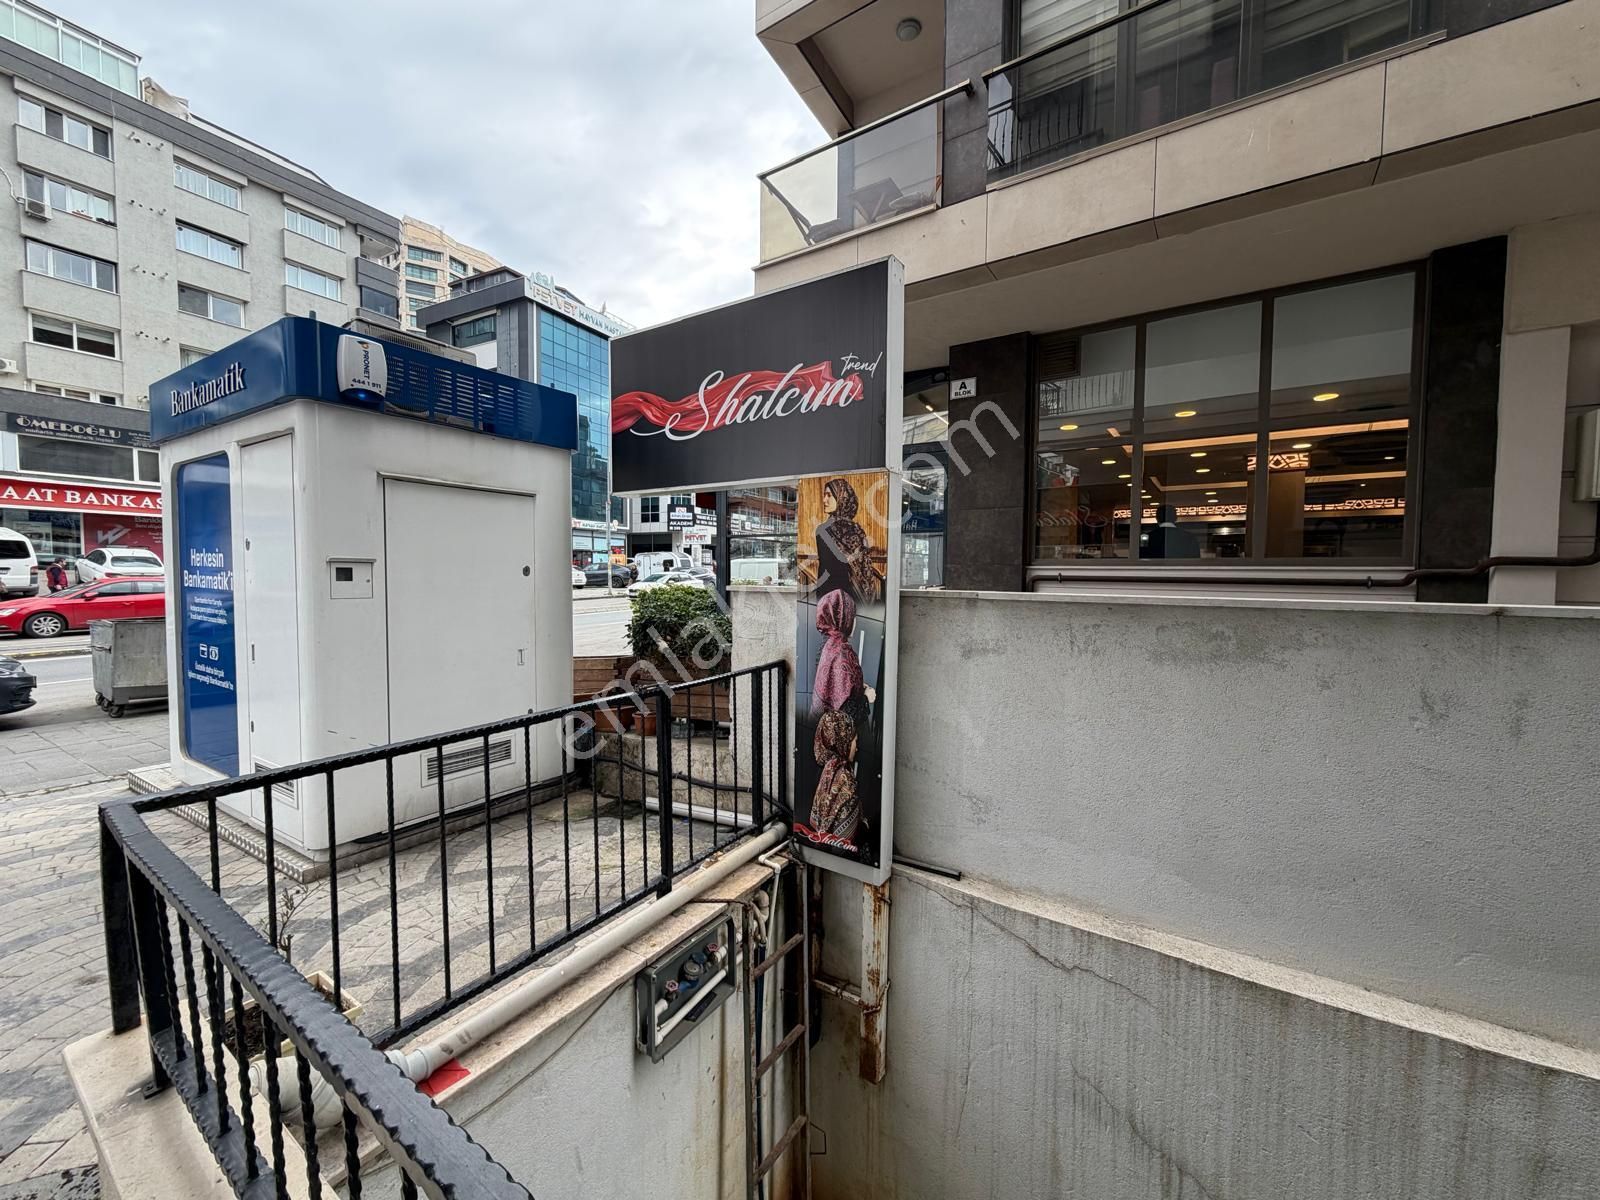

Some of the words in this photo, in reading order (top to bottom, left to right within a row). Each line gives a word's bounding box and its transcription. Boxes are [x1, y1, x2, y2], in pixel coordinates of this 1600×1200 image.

[362, 350, 370, 379] PRONET
[840, 351, 883, 379] Trend
[170, 361, 245, 417] Bankamatik
[959, 381, 967, 390] A
[16, 415, 121, 439] ÖMEROĞLU
[190, 548, 224, 568] Herkesin
